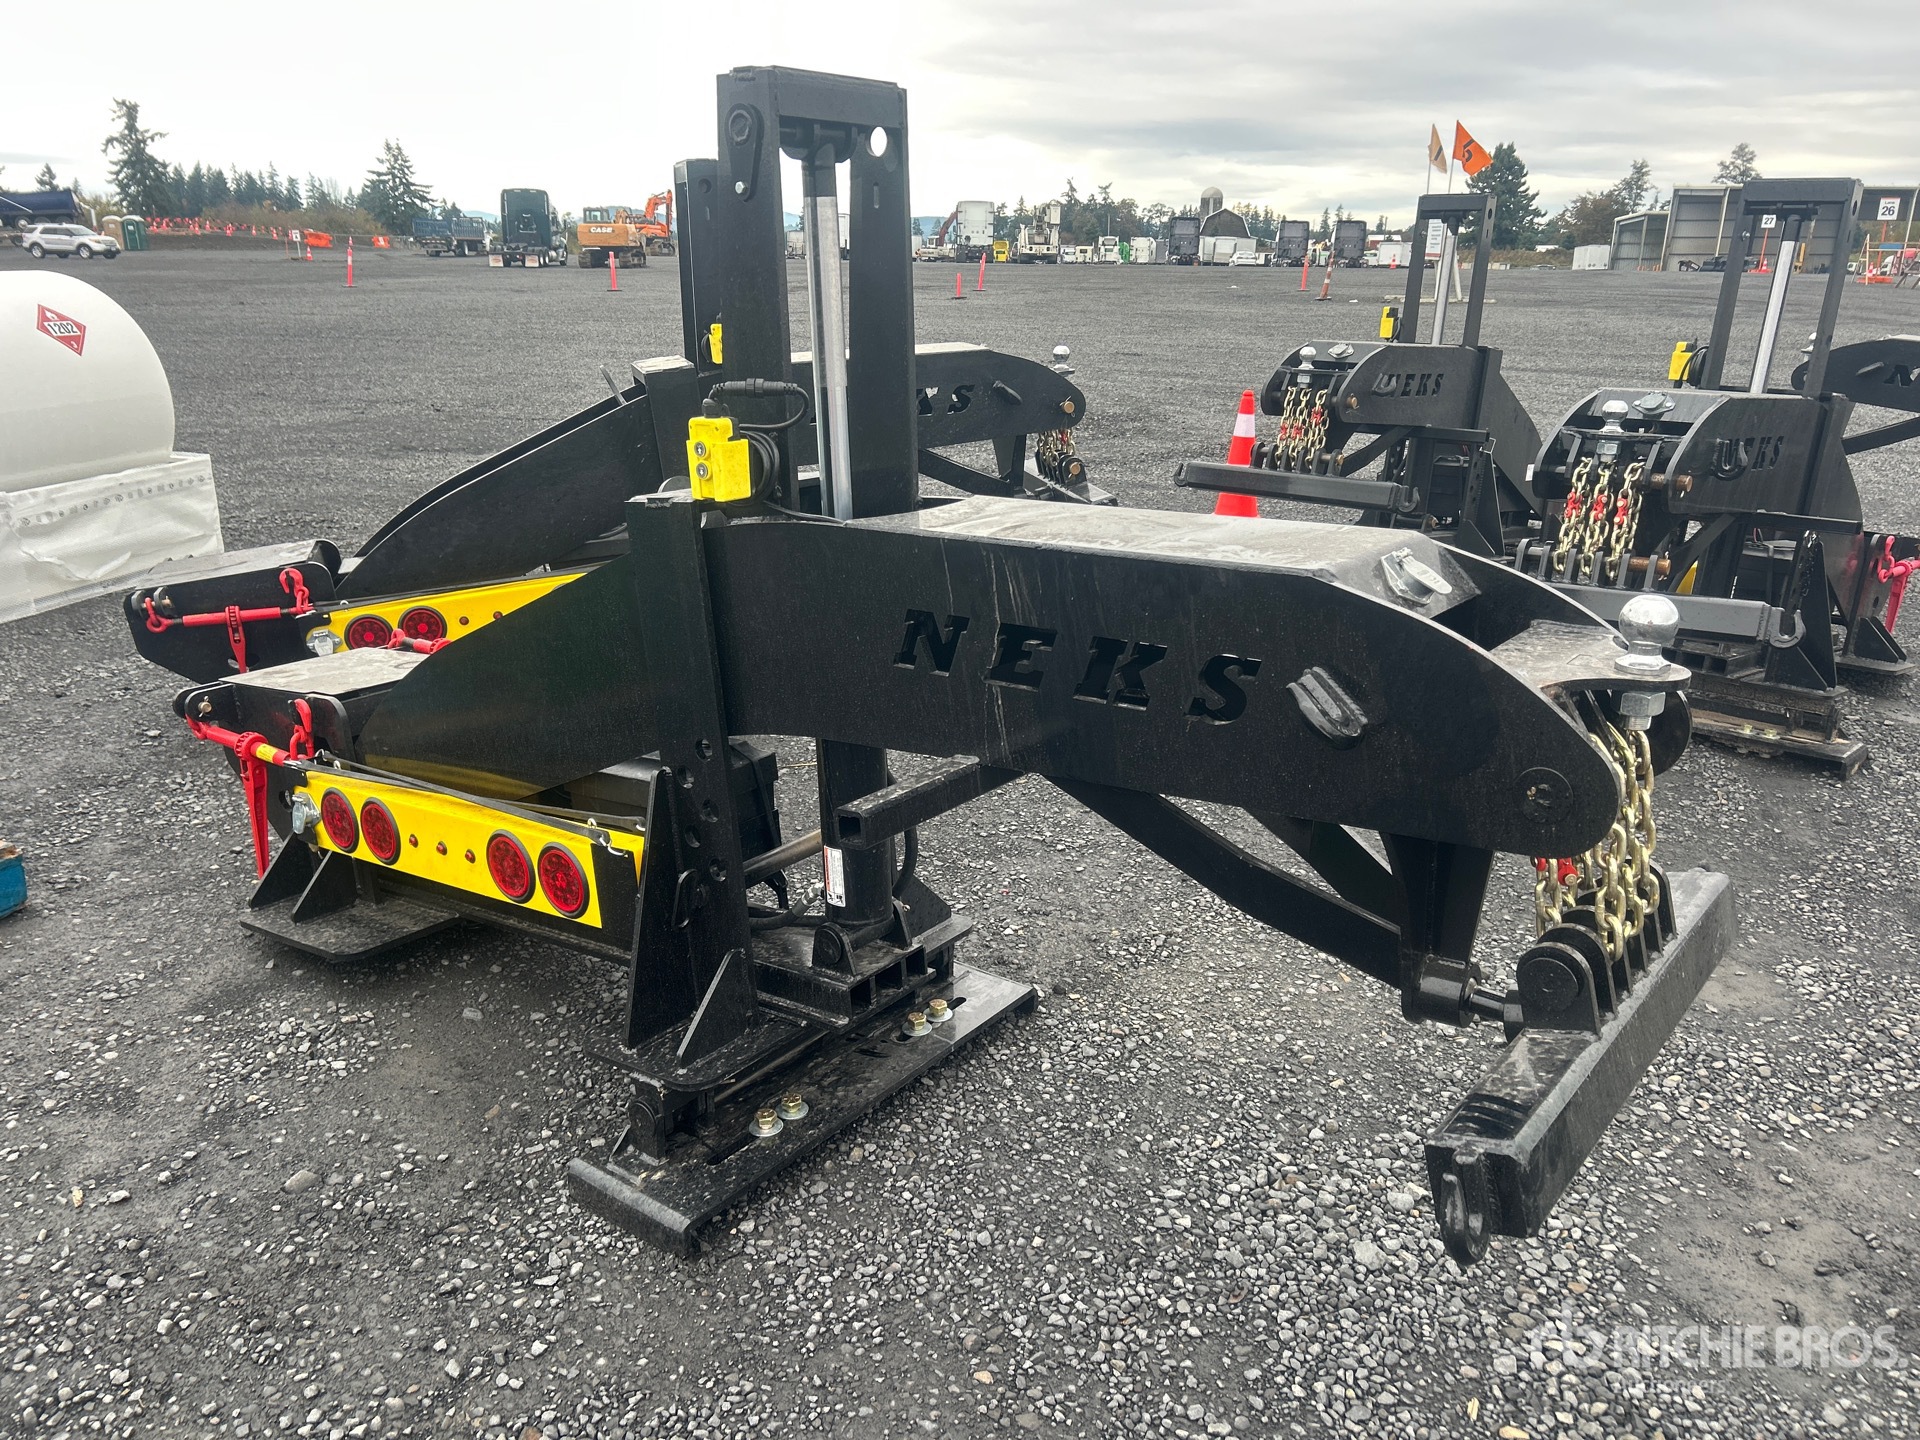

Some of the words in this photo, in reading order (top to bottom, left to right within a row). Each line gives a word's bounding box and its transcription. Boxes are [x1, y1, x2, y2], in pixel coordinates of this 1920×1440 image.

[1881, 205, 1896, 216] 26
[1764, 217, 1775, 225] 27
[47, 322, 79, 335] 1202
[893, 608, 1262, 726] NEKS
